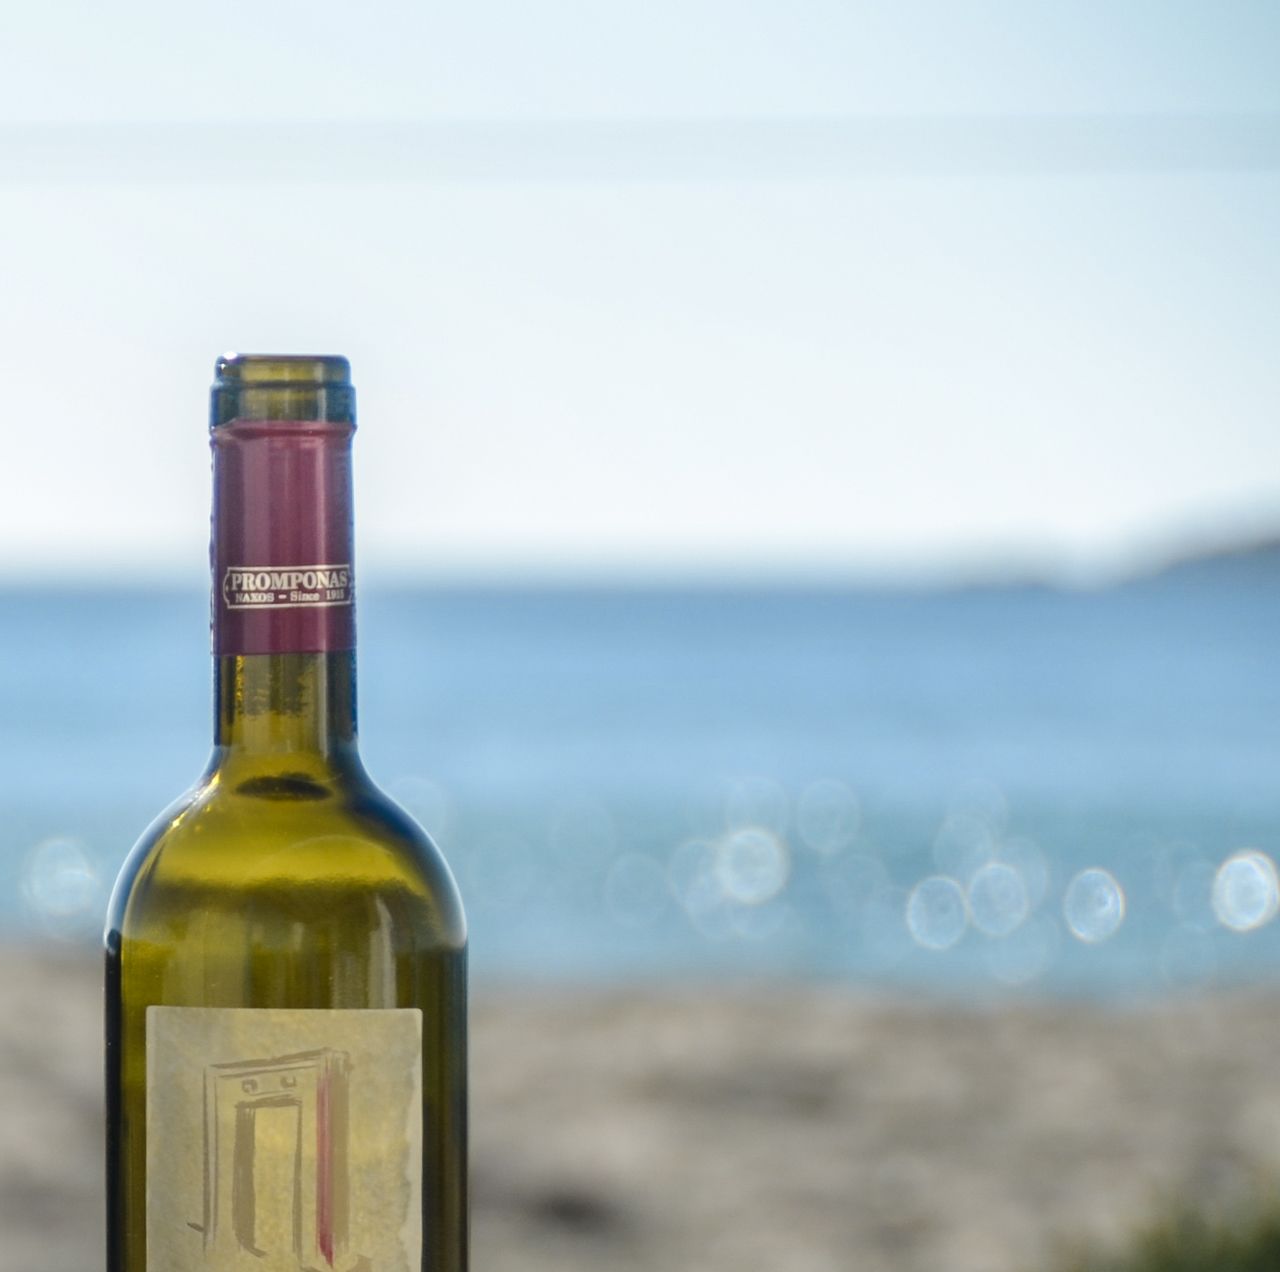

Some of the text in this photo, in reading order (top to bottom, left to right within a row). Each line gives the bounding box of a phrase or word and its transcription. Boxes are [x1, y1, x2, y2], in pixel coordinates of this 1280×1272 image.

[231, 571, 348, 591] PROMPONAS
[235, 592, 274, 603] NAXOS
[290, 591, 319, 601] Since
